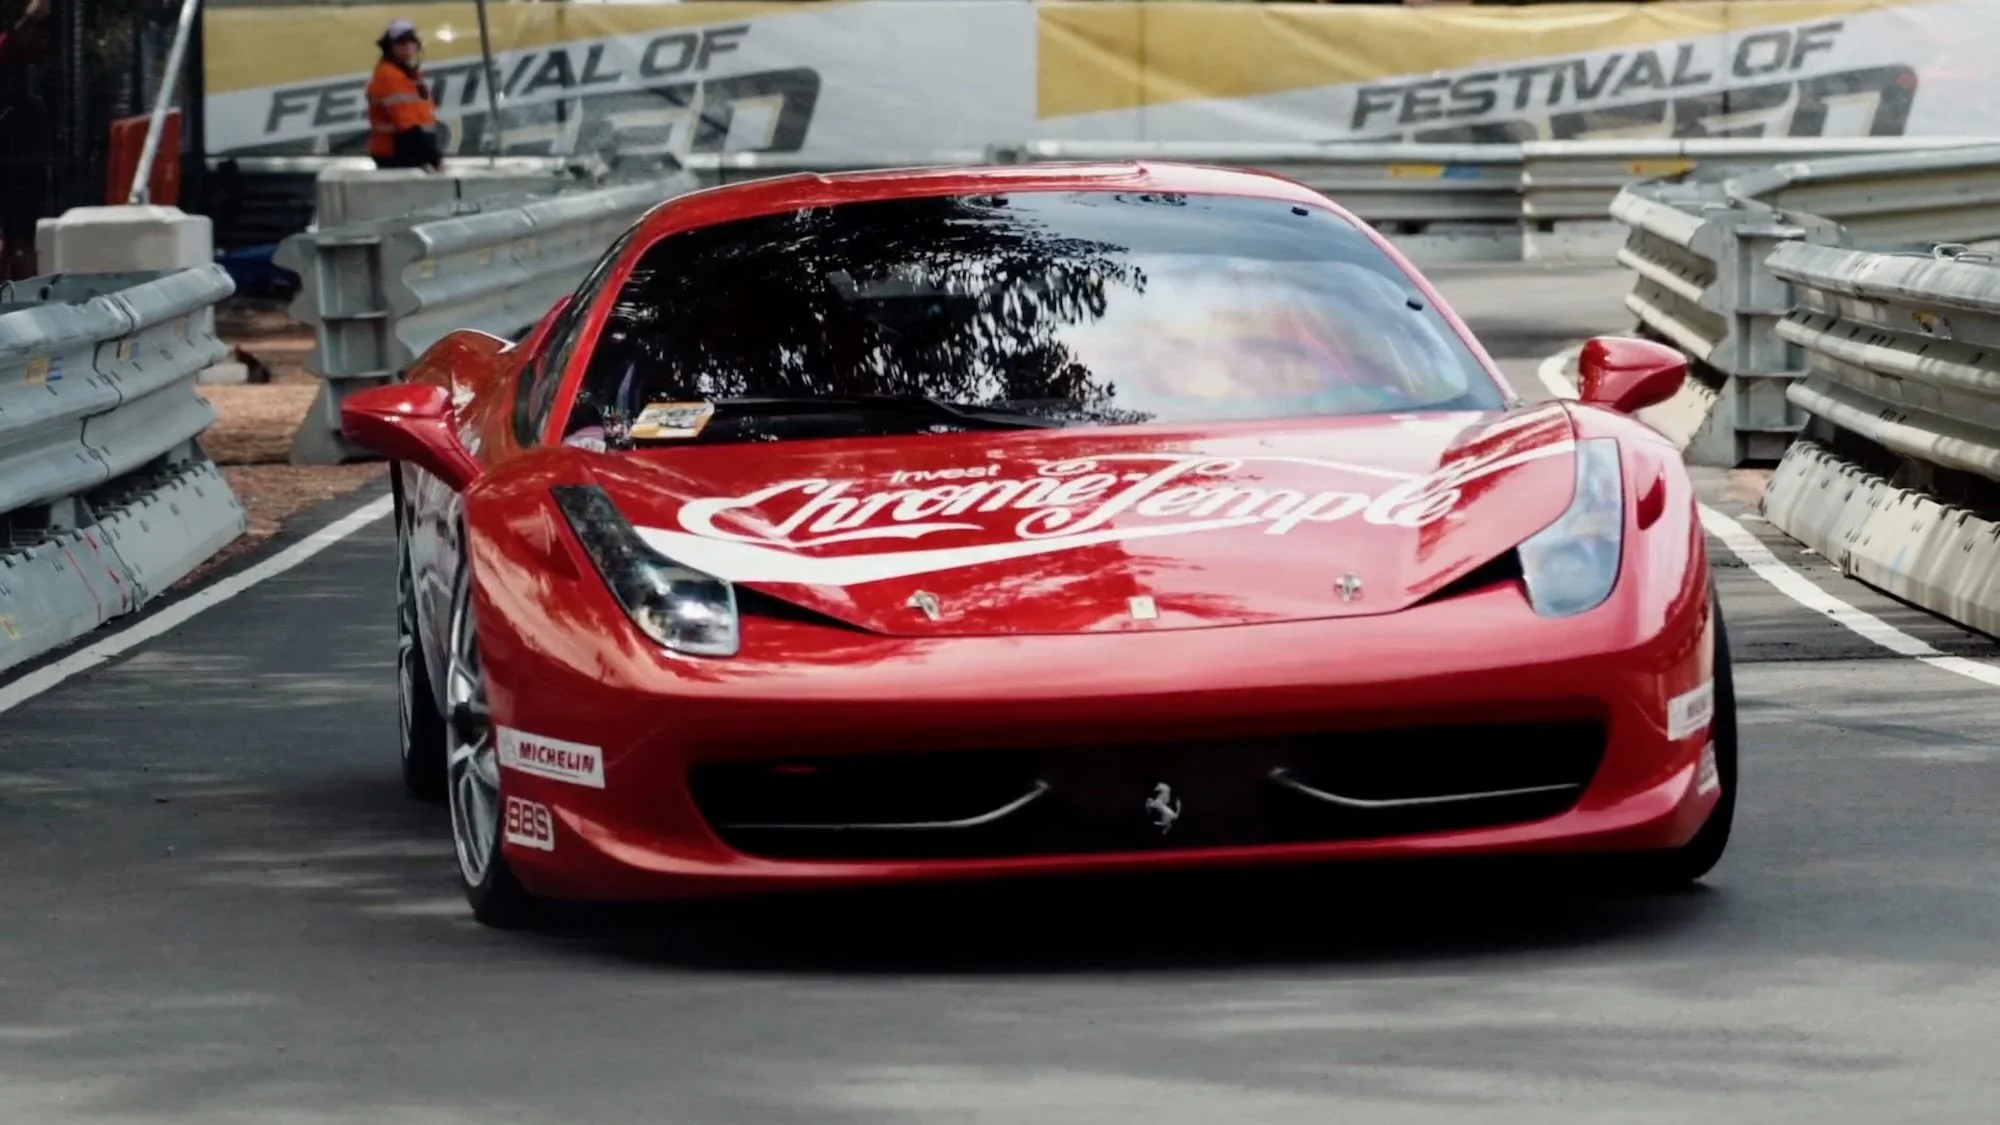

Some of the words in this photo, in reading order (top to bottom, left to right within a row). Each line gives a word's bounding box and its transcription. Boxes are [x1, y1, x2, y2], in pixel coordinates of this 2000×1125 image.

[264, 44, 621, 134] FETIVAL
[640, 25, 750, 79] OF
[1351, 43, 1711, 130] FESTIVAL
[1732, 22, 1844, 78] OF
[677, 474, 1117, 548] Chrome
[1015, 454, 1463, 538] Temple
[519, 741, 595, 773] MICHELIN
[507, 800, 549, 841] BBS
